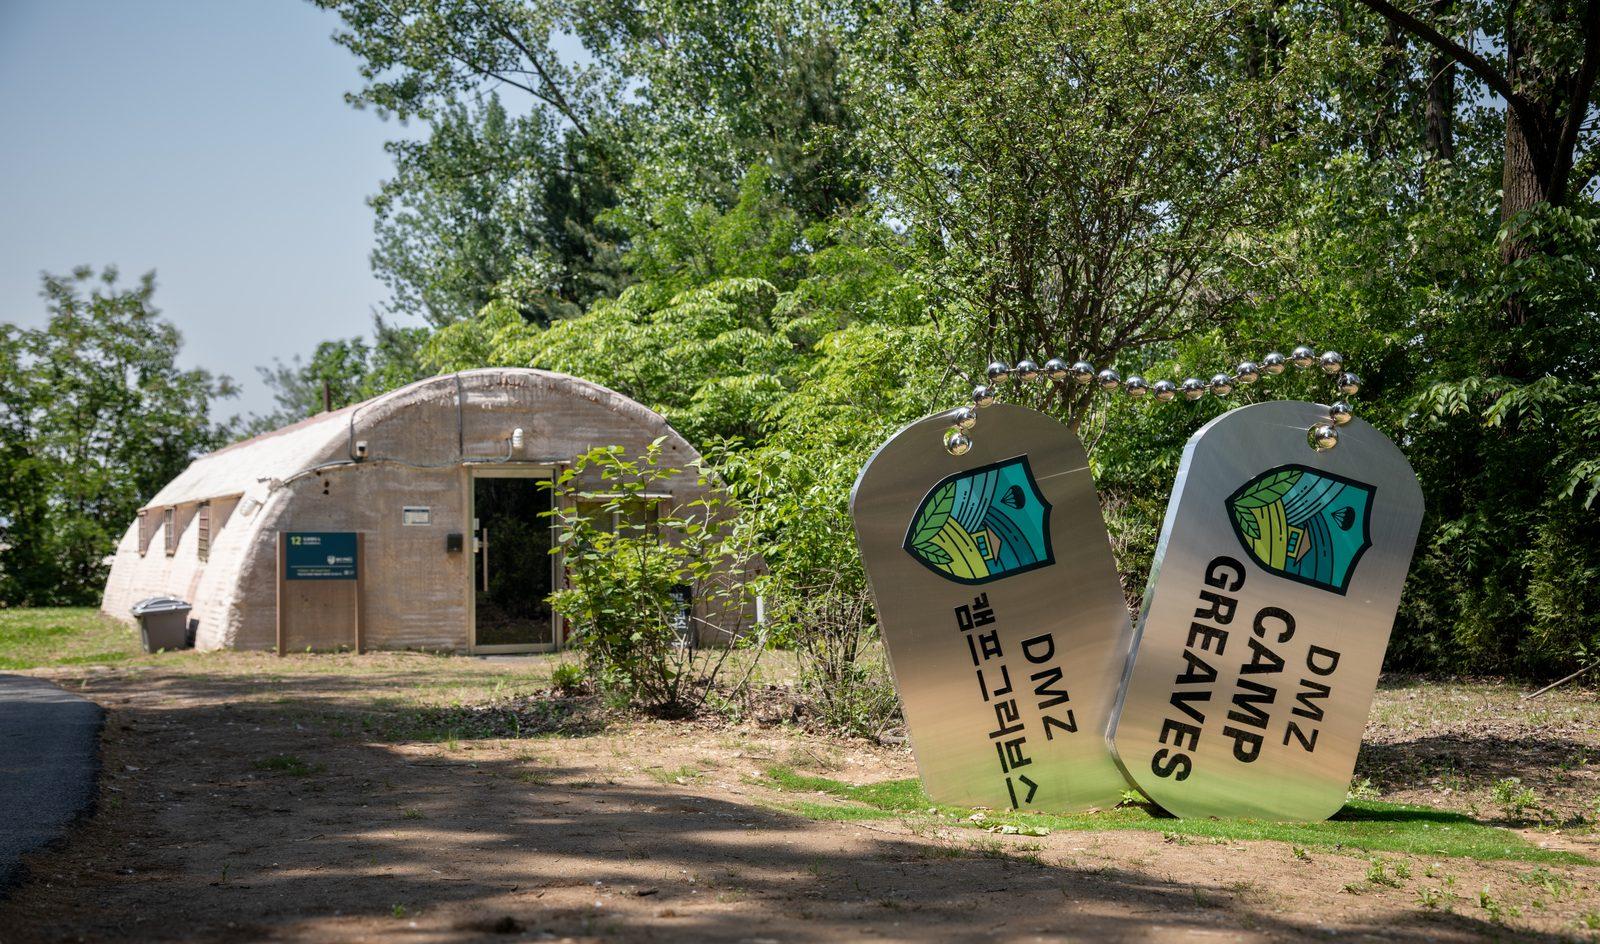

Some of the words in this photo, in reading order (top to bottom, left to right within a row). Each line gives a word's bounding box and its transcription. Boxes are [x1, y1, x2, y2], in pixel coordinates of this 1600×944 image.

[291, 536, 301, 545] 12
[954, 592, 1039, 810] 캠프그리브스
[1021, 633, 1078, 741] DMZ
[1151, 555, 1247, 782] GREAVES
[1222, 606, 1296, 764] CAMP
[1283, 644, 1341, 753] DMZ
